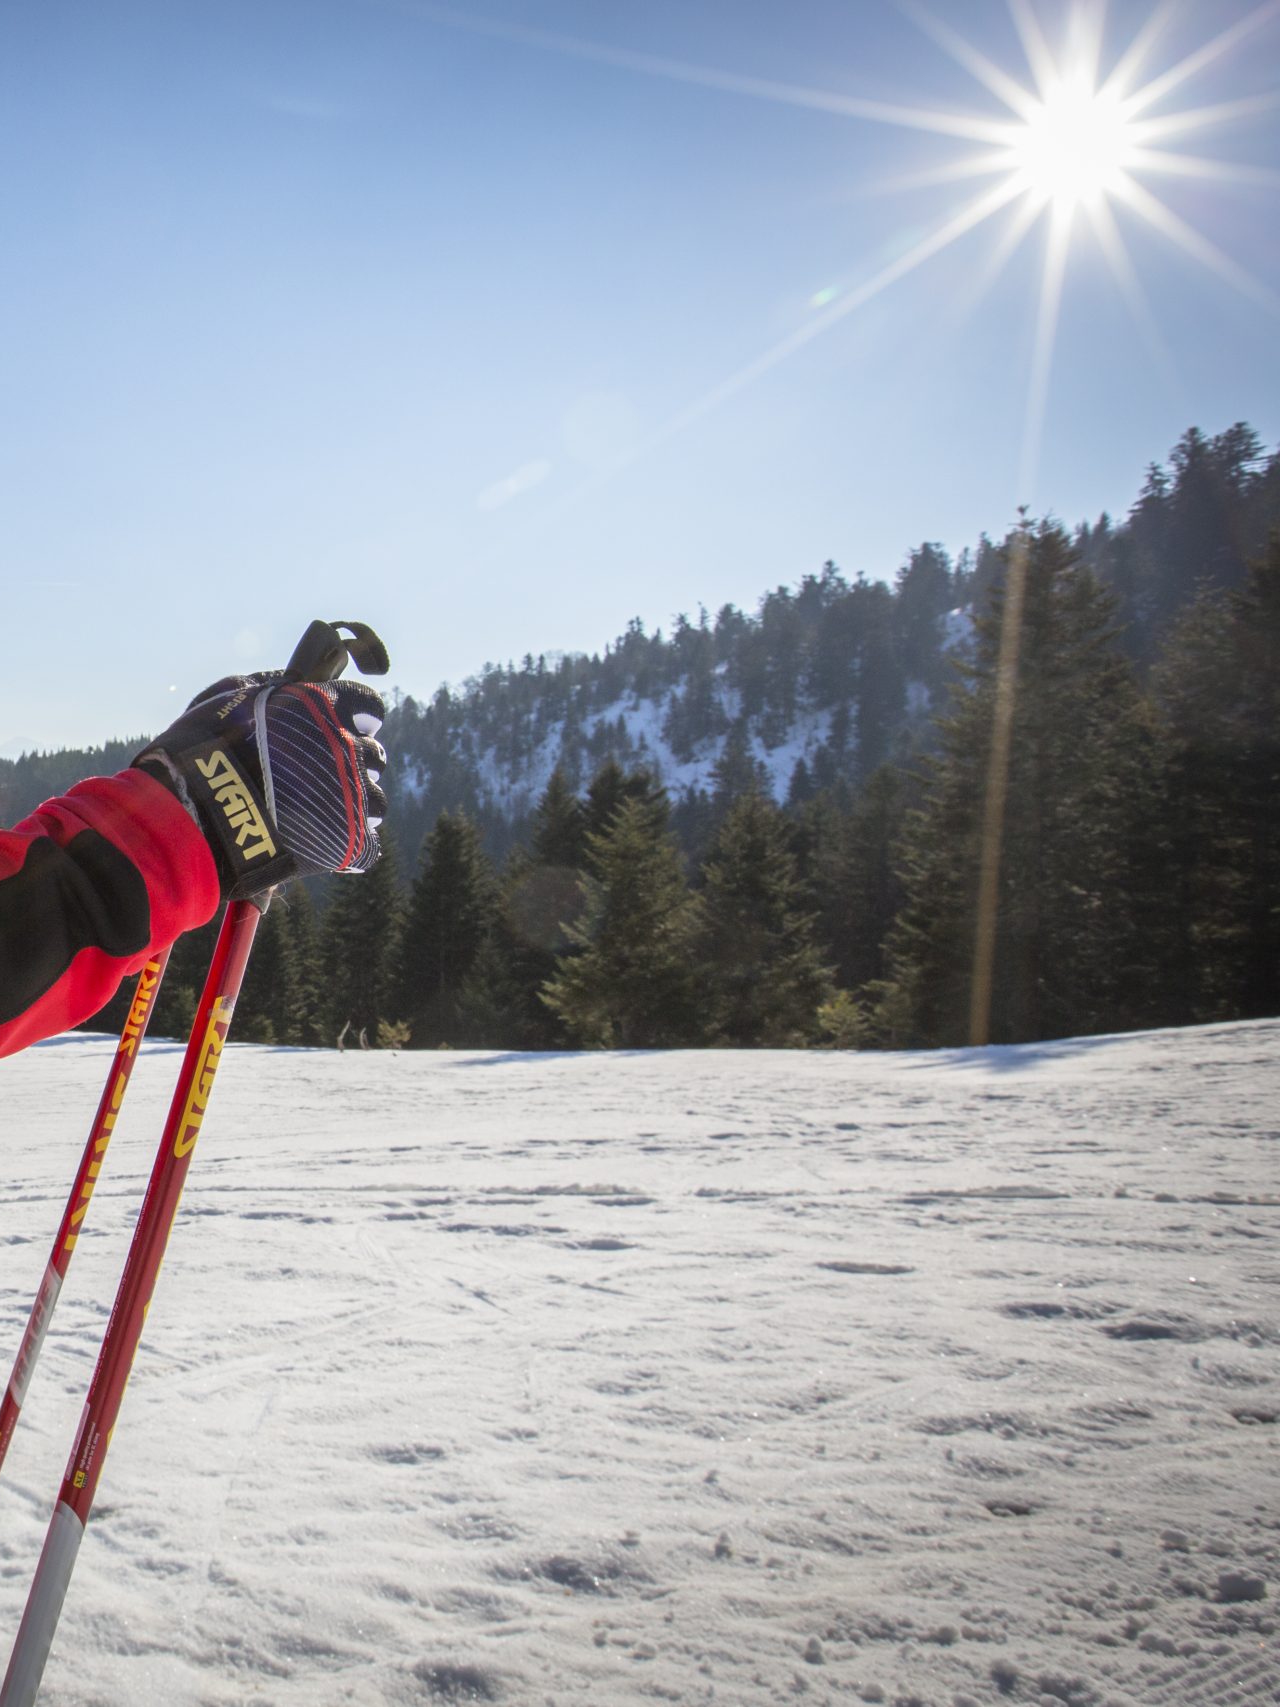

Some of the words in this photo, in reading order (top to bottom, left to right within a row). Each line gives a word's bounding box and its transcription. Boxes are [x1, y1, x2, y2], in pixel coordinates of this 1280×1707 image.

[194, 750, 277, 861] START
[118, 961, 161, 1058] START
[173, 996, 235, 1159] START
[16, 1286, 50, 1388] RACE
